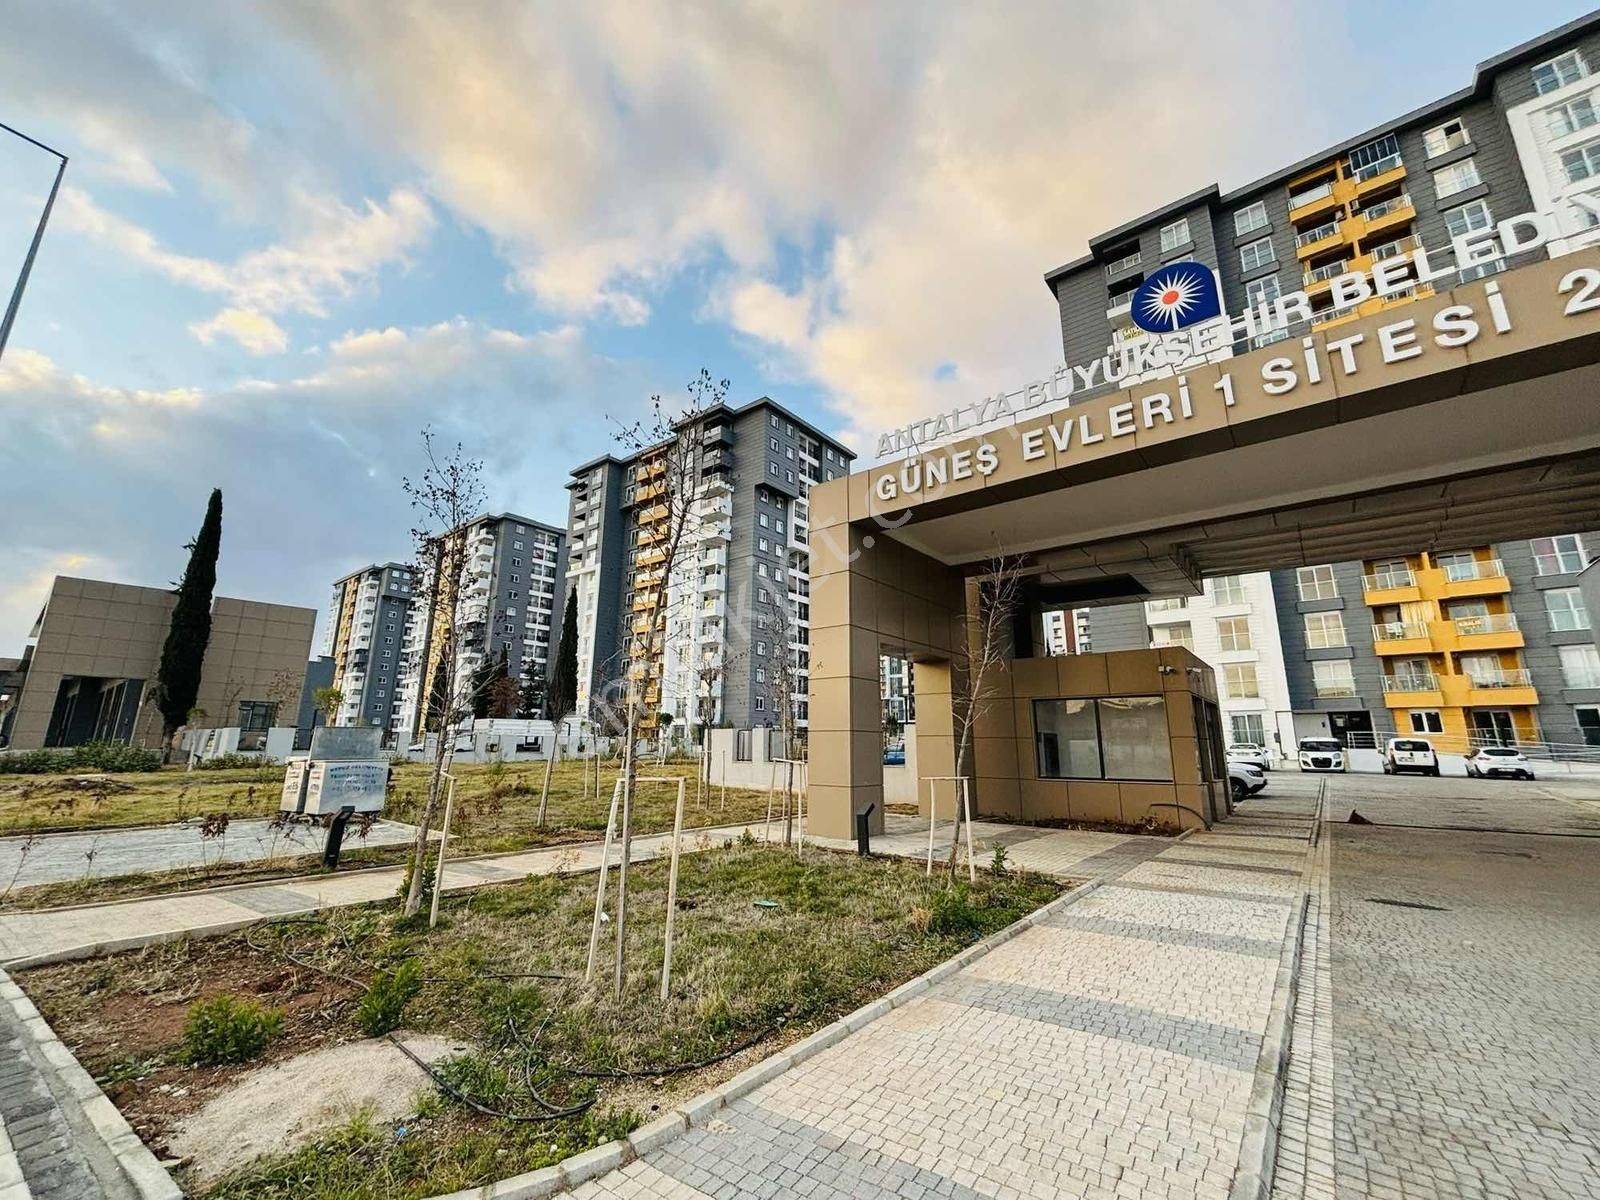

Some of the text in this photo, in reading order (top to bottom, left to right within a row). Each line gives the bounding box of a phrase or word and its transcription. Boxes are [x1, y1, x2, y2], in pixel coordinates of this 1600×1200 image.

[874, 391, 1013, 459] ANTALYA
[876, 268, 1600, 501] GÜNEŞ EVLERİ 1 SİTESİ 2
